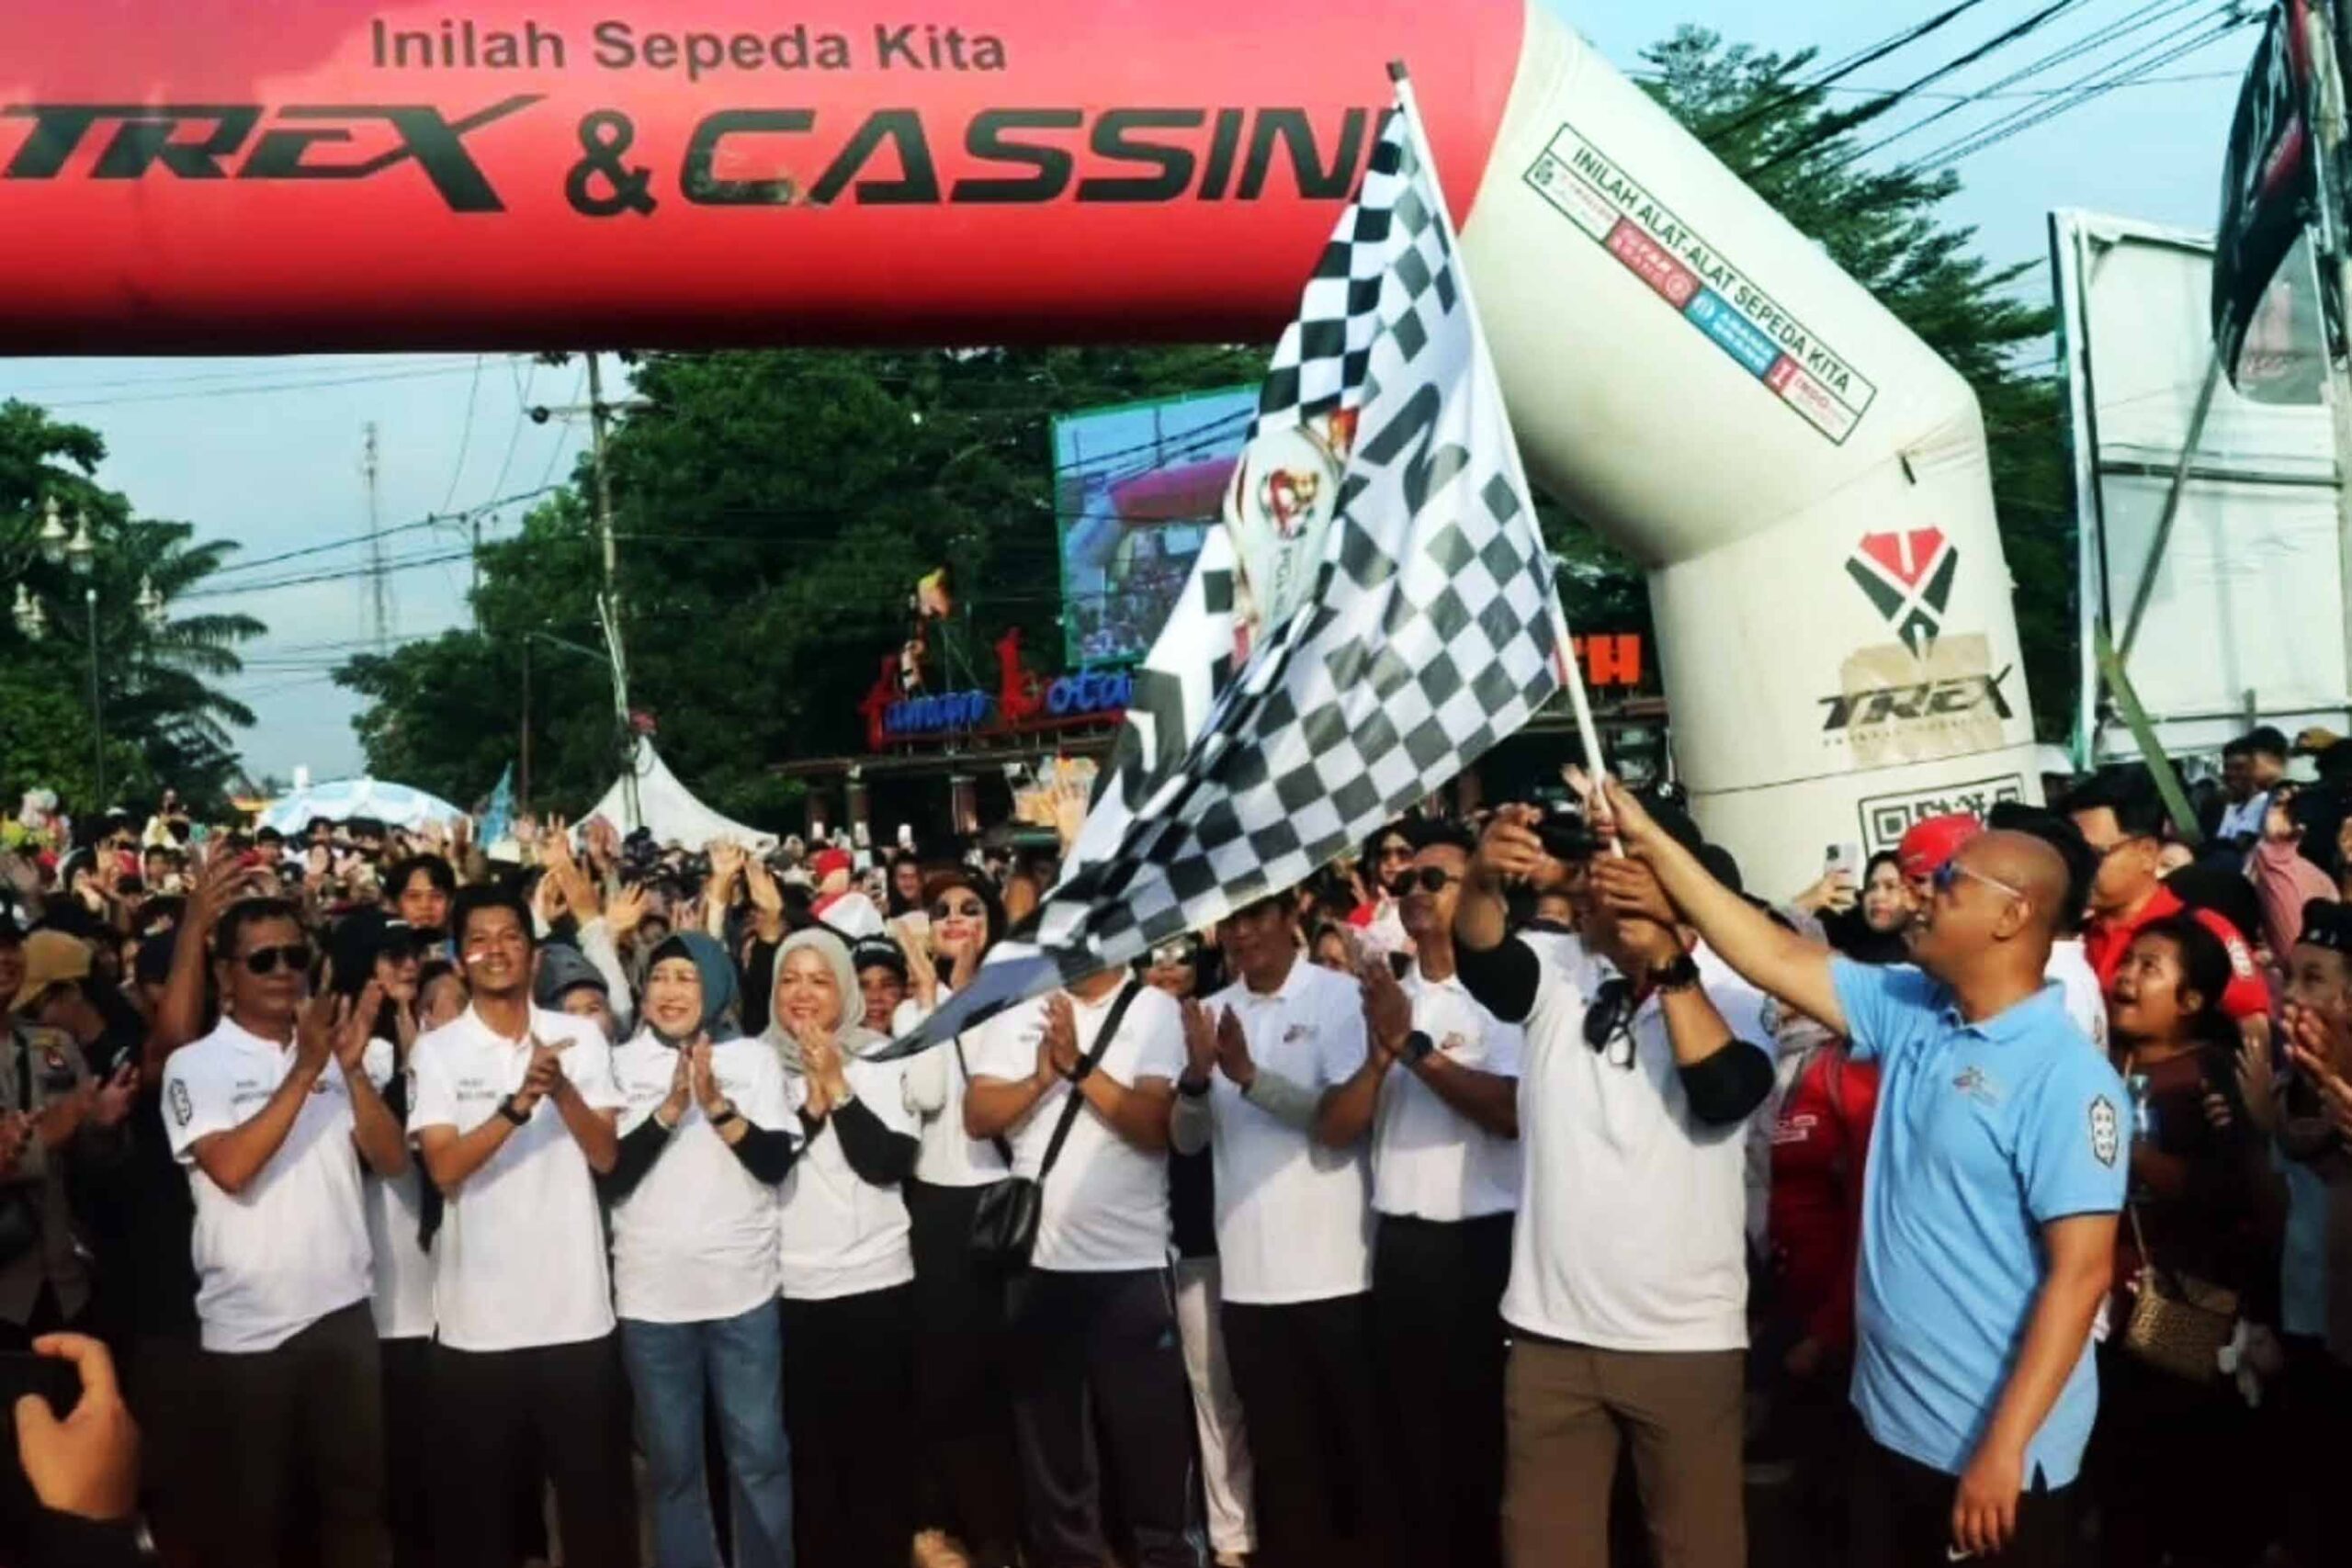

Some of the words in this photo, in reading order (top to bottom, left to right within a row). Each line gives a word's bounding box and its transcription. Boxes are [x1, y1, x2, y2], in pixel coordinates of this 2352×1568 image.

[372, 19, 566, 70] Inilah
[593, 21, 850, 82] Sepeda
[875, 23, 1006, 71] Kita
[1, 95, 548, 213] TREX
[565, 109, 659, 217] &
[1573, 147, 1638, 210] INILAH
[1637, 203, 1736, 294] ALAT-ALAT
[1734, 286, 1807, 357] SEPEDA
[1808, 351, 1850, 394] KITA
